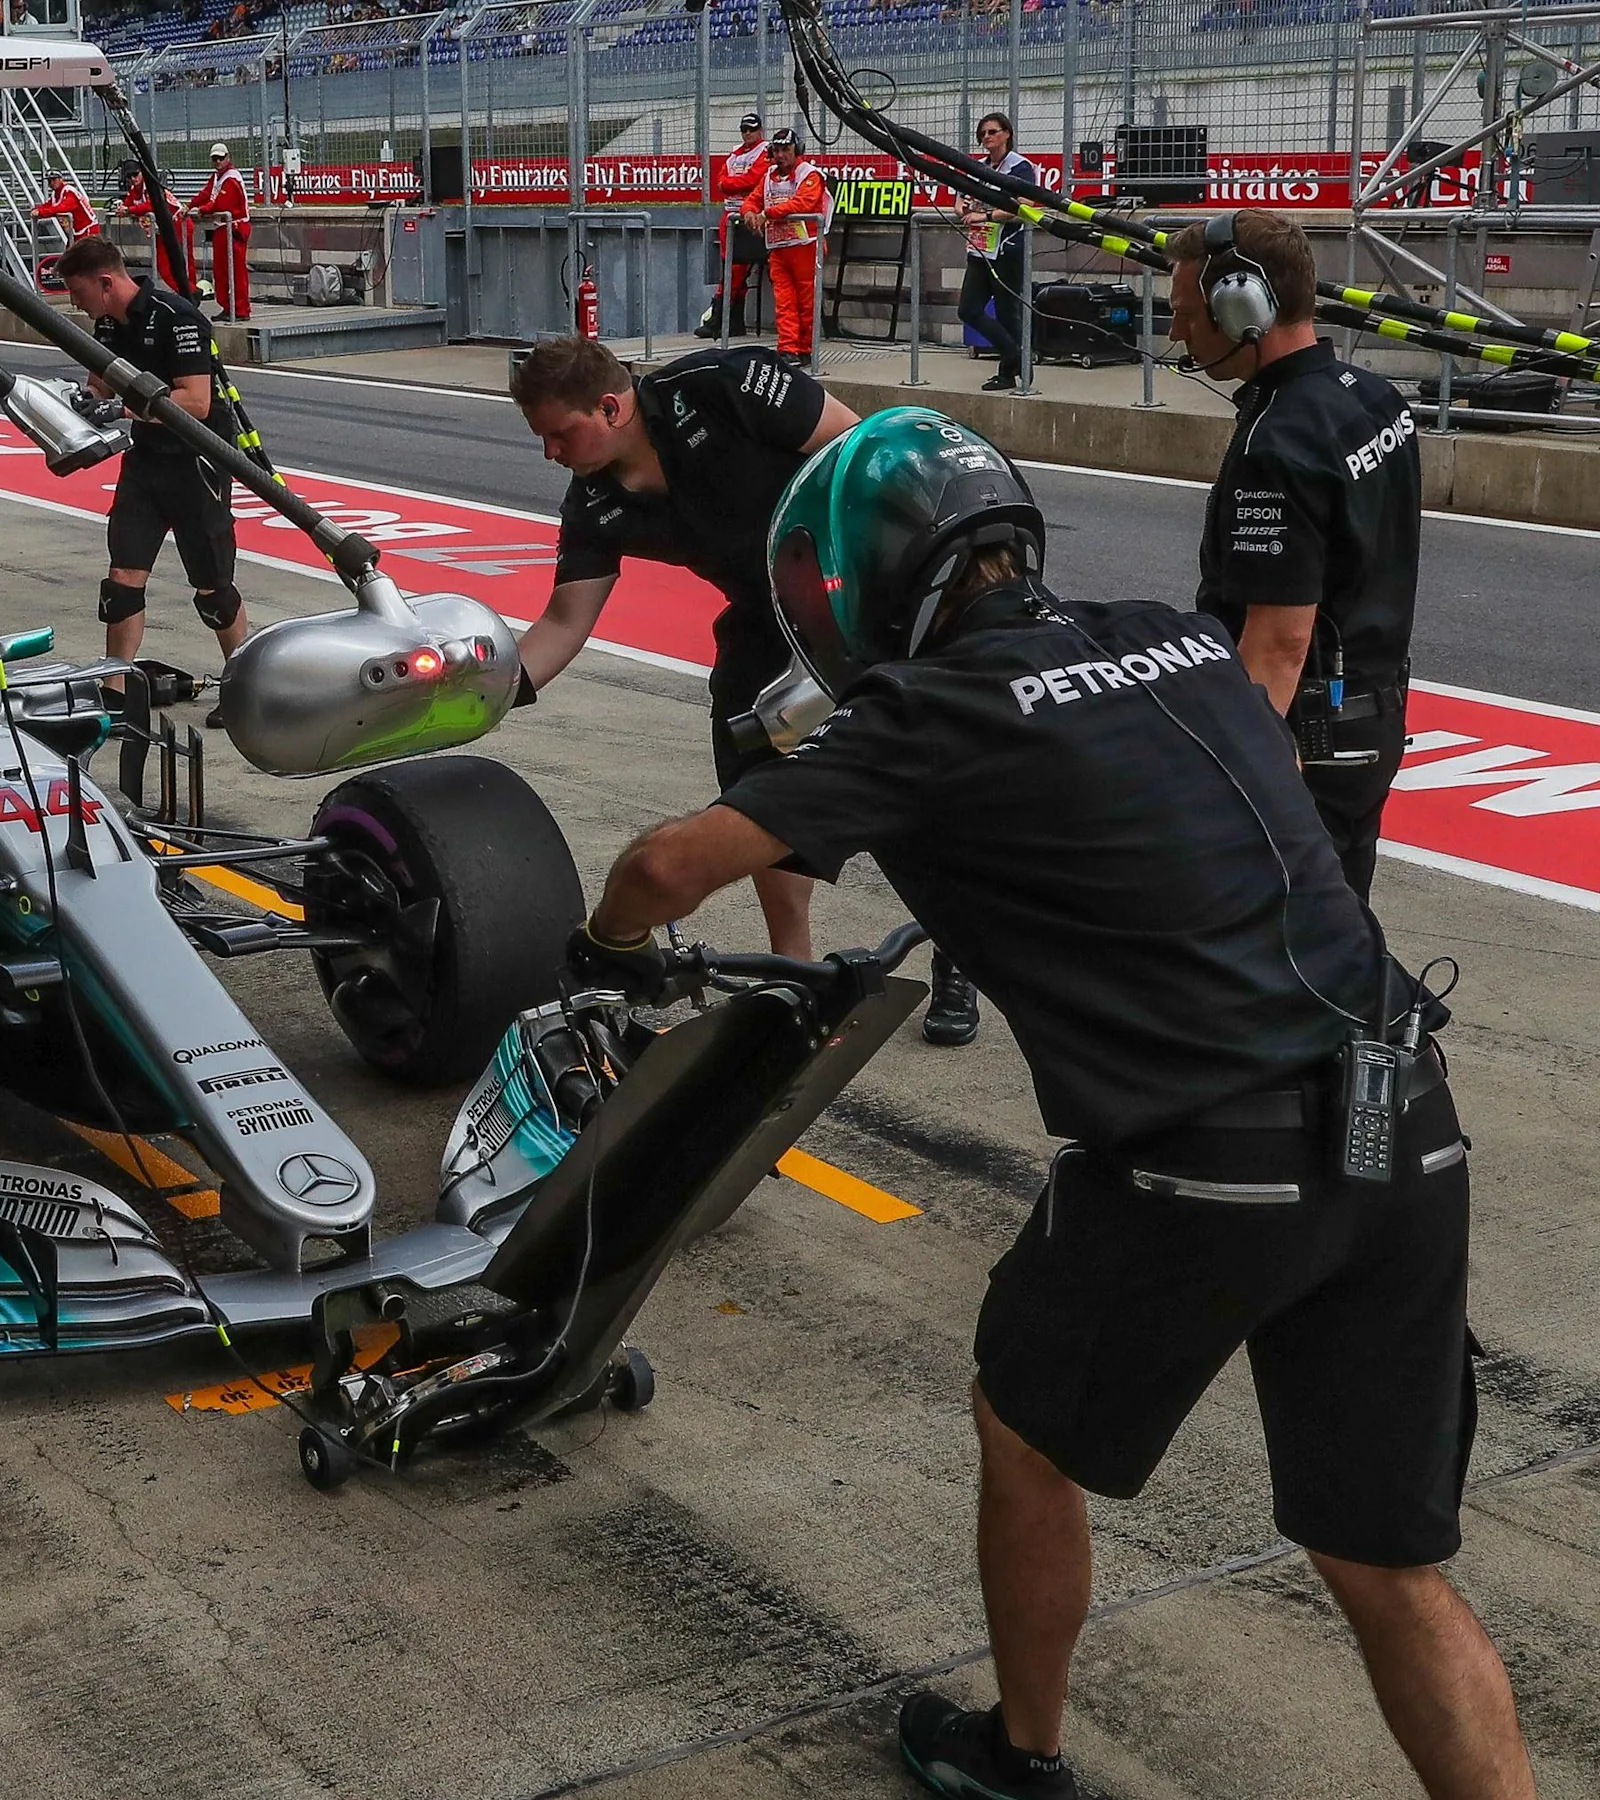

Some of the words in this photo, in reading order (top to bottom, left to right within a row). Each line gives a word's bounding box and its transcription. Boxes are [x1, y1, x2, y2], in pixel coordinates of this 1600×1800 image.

[1082, 150, 1098, 164] 10
[351, 167, 376, 199] Fly
[471, 163, 487, 198] ly
[489, 162, 568, 191] Emirates
[753, 363, 772, 397] EPSON
[1234, 488, 1286, 503] QUALCOMM
[1236, 507, 1282, 520] EPSON
[1230, 526, 1288, 536] BOSE
[1233, 540, 1269, 553] Allianz
[1008, 633, 1232, 716] PETRONAS
[196, 1066, 289, 1095] PIRELLI
[226, 1097, 304, 1119] PETRONAS
